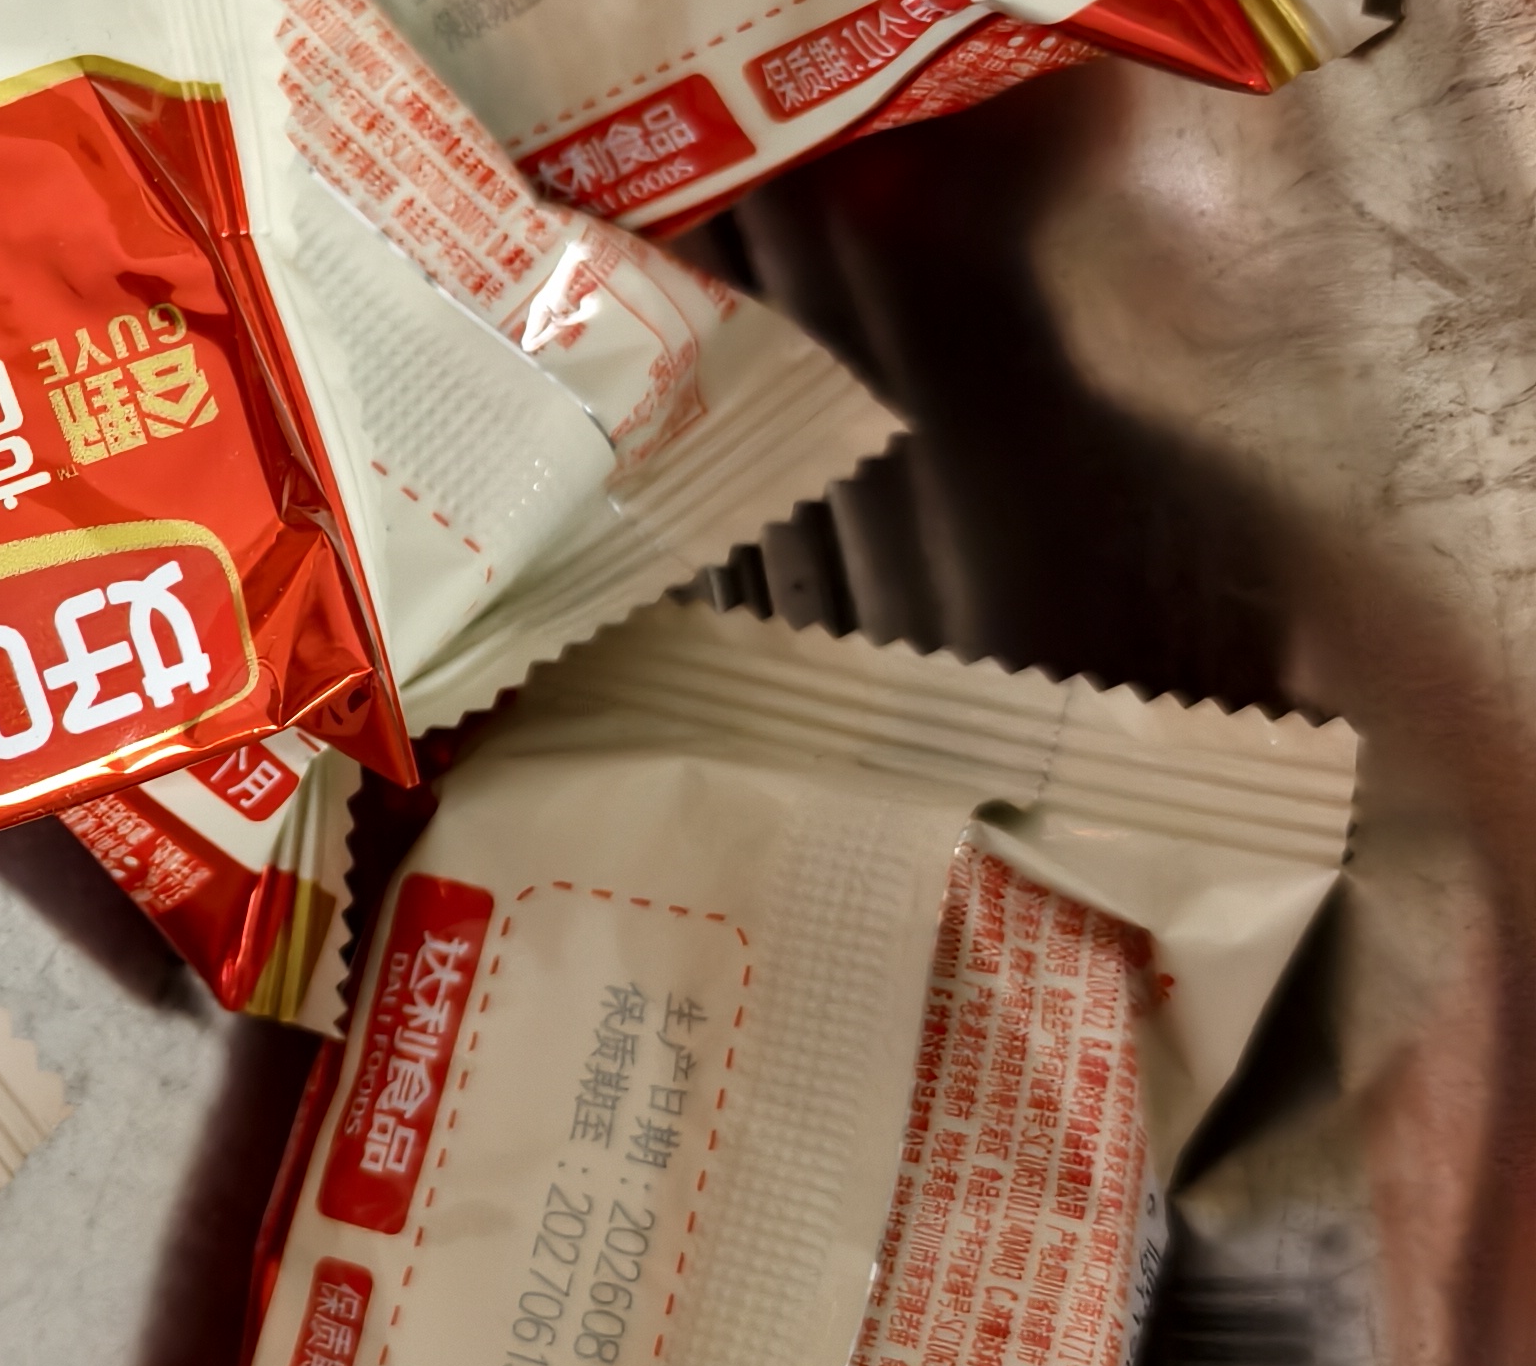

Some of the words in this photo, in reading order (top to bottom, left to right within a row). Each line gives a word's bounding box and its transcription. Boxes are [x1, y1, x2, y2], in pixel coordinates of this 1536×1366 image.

[36, 303, 189, 377] GUYE
[359, 930, 469, 1175] 达利食品
